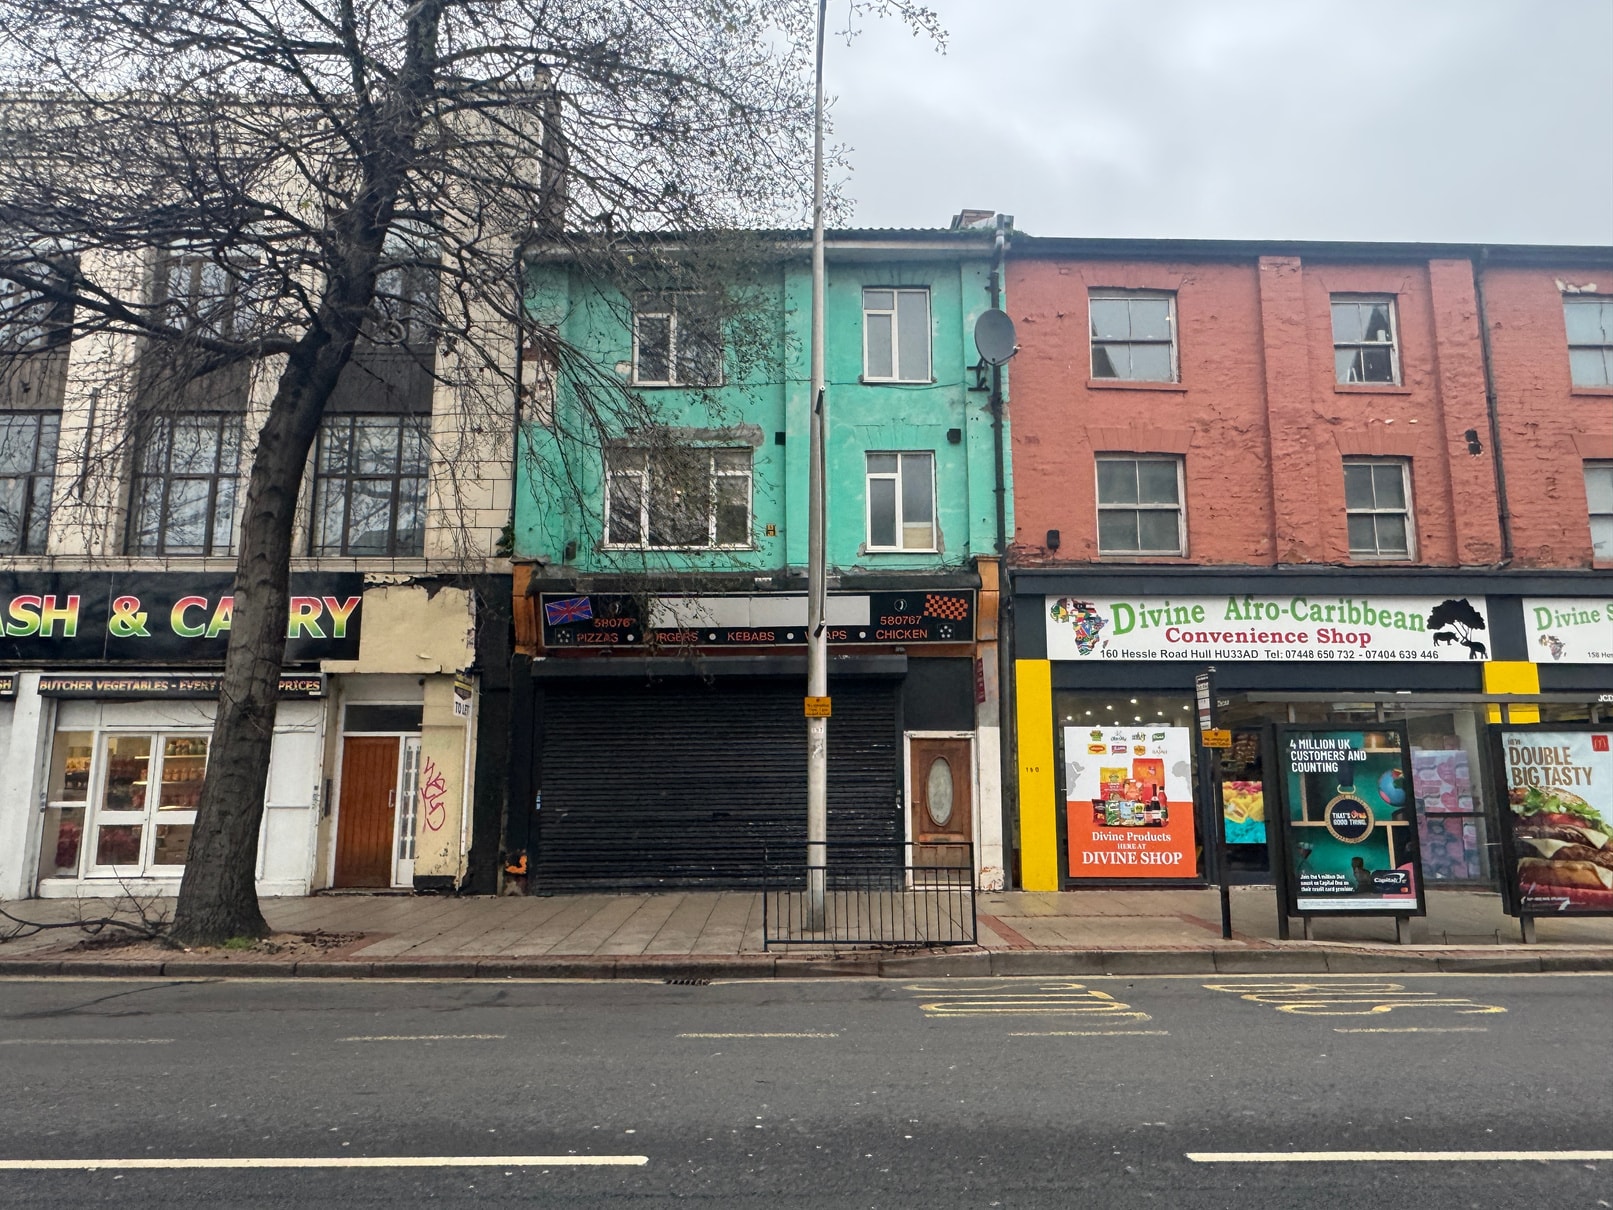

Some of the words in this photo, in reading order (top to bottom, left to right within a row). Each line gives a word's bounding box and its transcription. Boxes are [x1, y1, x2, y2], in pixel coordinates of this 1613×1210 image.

[0, 595, 80, 637] SH
[109, 595, 151, 637] &
[170, 595, 361, 638] CARY
[880, 616, 922, 625] 580767
[1110, 601, 1205, 636] Divine
[1224, 595, 1426, 632] Afro-Caribbean
[1533, 606, 1601, 631] Divine
[577, 632, 619, 643] PIZZAS
[643, 632, 699, 643] RGERS
[727, 631, 775, 641] KEBABS
[804, 630, 847, 640] APS
[876, 629, 928, 640] CHICKEN
[1165, 627, 1309, 643] Convenience
[1316, 628, 1372, 648] Shop
[1100, 650, 1118, 659] 160
[1122, 650, 1157, 659] Hessle
[1160, 650, 1188, 659] Road
[1191, 650, 1211, 659] Hull
[1215, 650, 1259, 659] HU33AD
[1264, 650, 1284, 659] Tel:
[1285, 650, 1314, 659] 07448
[1317, 650, 1334, 659] 650
[1337, 650, 1354, 659] 732
[1365, 650, 1396, 659] 07404
[1398, 650, 1417, 659] 639
[1420, 650, 1439, 659] 446
[40, 680, 94, 691] BUTCHER
[96, 680, 168, 691] VEGETABLES
[179, 680, 217, 690] EVERY
[278, 680, 321, 691] PRICES
[1290, 739, 1296, 749] 4
[1299, 739, 1335, 749] MILLION
[1337, 739, 1351, 749] UK
[1290, 751, 1345, 761] CUSTOMERS
[1347, 751, 1367, 761] AND
[1508, 747, 1573, 766] DOUBLE
[1291, 762, 1339, 772] COUNTING
[1511, 767, 1540, 786] BIG
[1540, 767, 1593, 786] TASTY
[1092, 832, 1125, 842] Divine
[1126, 832, 1171, 842] Products
[1082, 851, 1137, 865] DIVINE
[1140, 851, 1183, 865] SHOP
